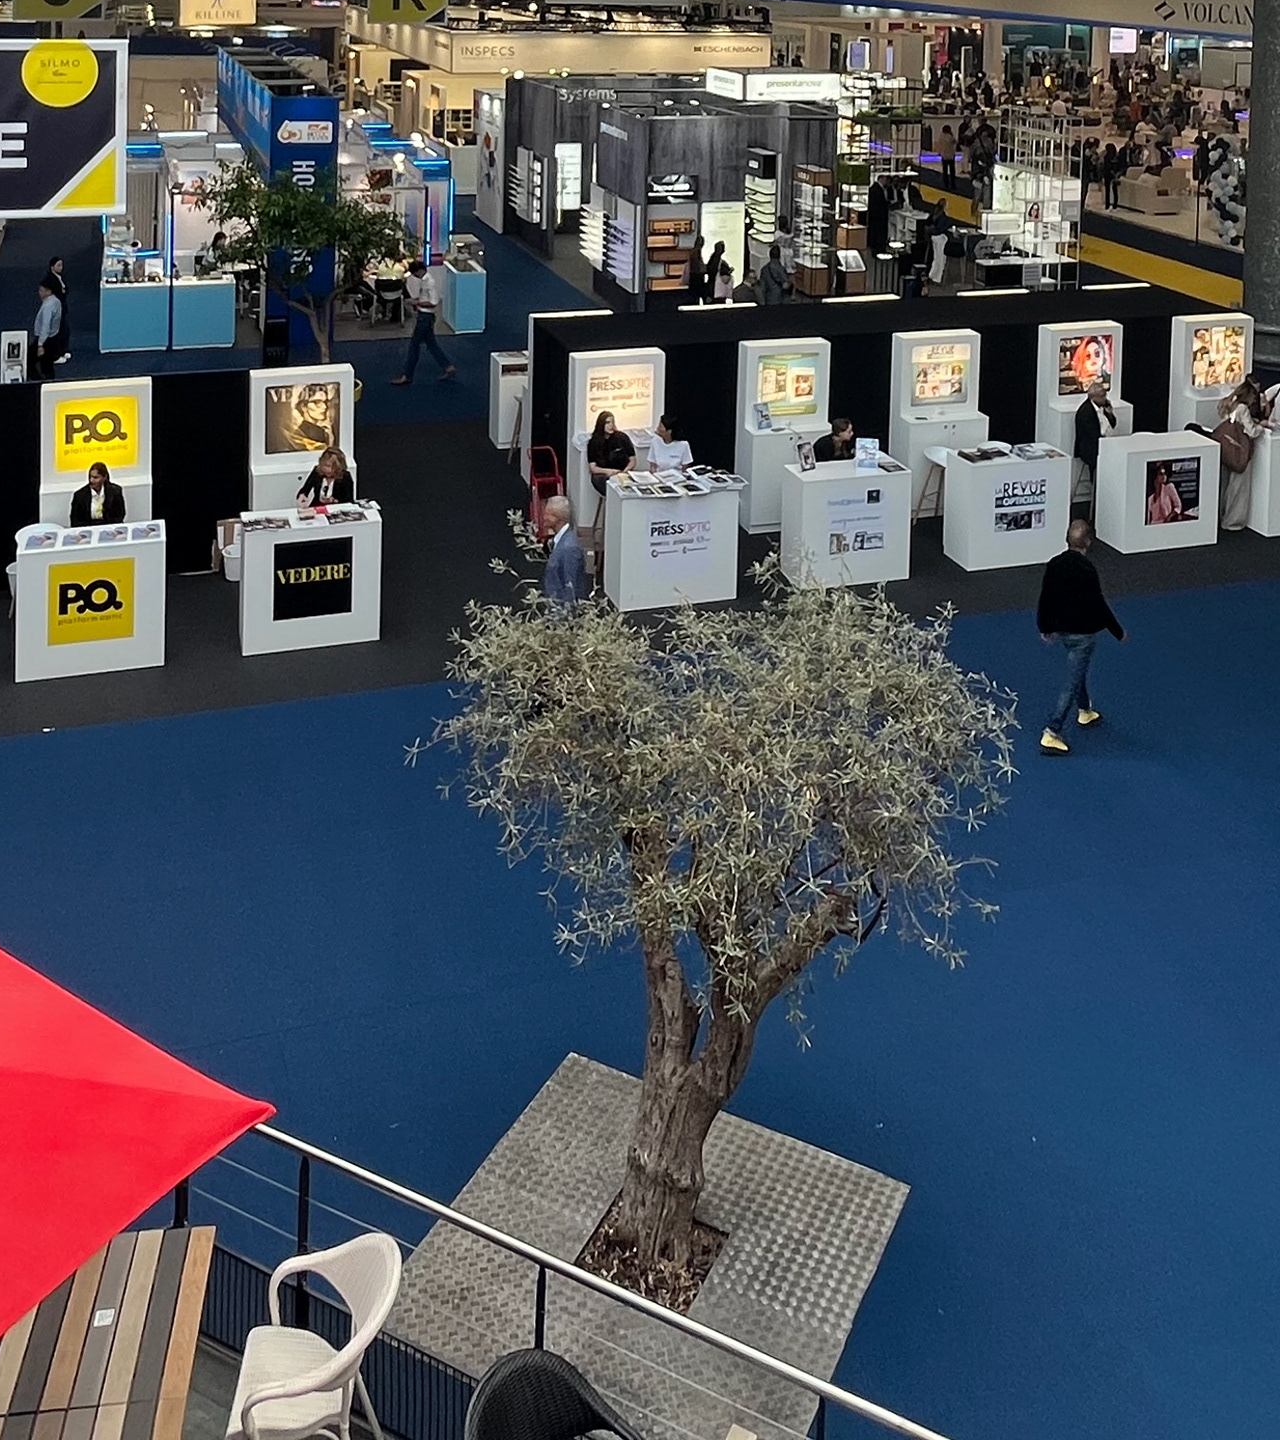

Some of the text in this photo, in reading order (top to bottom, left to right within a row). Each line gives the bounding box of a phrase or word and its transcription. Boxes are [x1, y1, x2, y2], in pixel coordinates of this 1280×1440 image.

[460, 45, 516, 56] INSPECS
[39, 59, 81, 69] SILMO
[1003, 479, 1047, 498] REVUE
[650, 521, 711, 537] PRESSOPTIC
[276, 562, 351, 585] VEDERE
